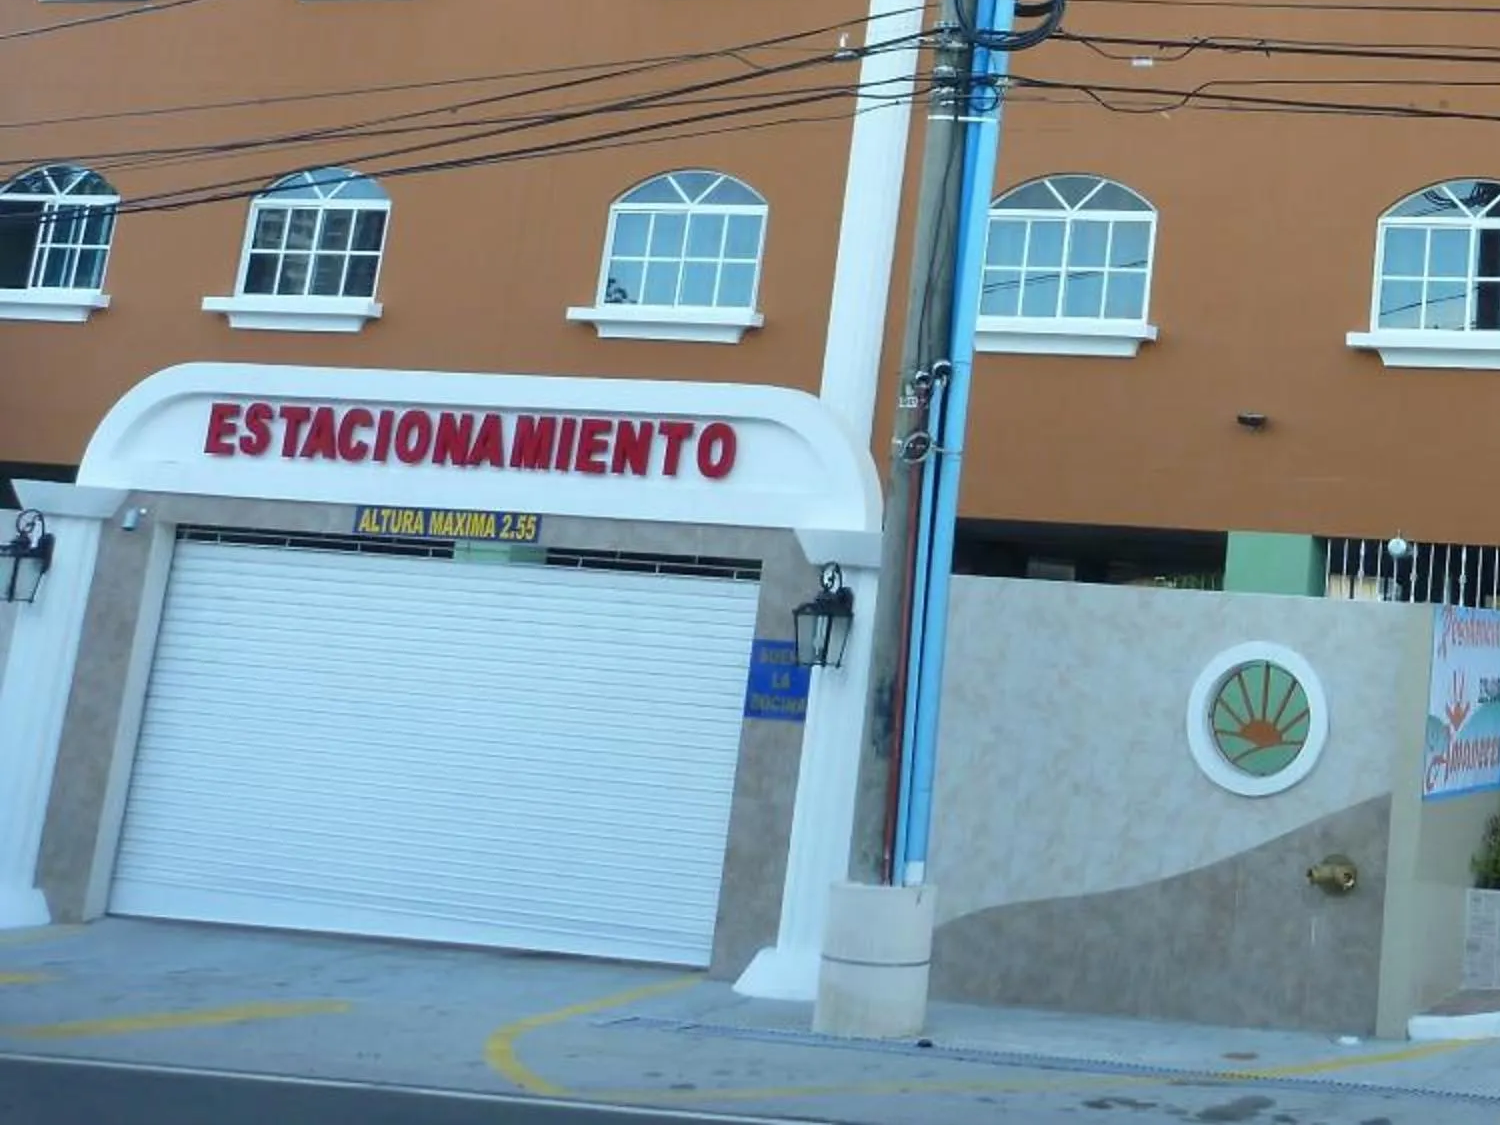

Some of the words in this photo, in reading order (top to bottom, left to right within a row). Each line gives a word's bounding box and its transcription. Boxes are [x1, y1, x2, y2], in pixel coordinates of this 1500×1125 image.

[204, 402, 738, 479] ESTACIONAMIENTO
[358, 507, 425, 535] ALTURA
[428, 510, 497, 537] MAXIMA
[499, 514, 537, 540] 2.55
